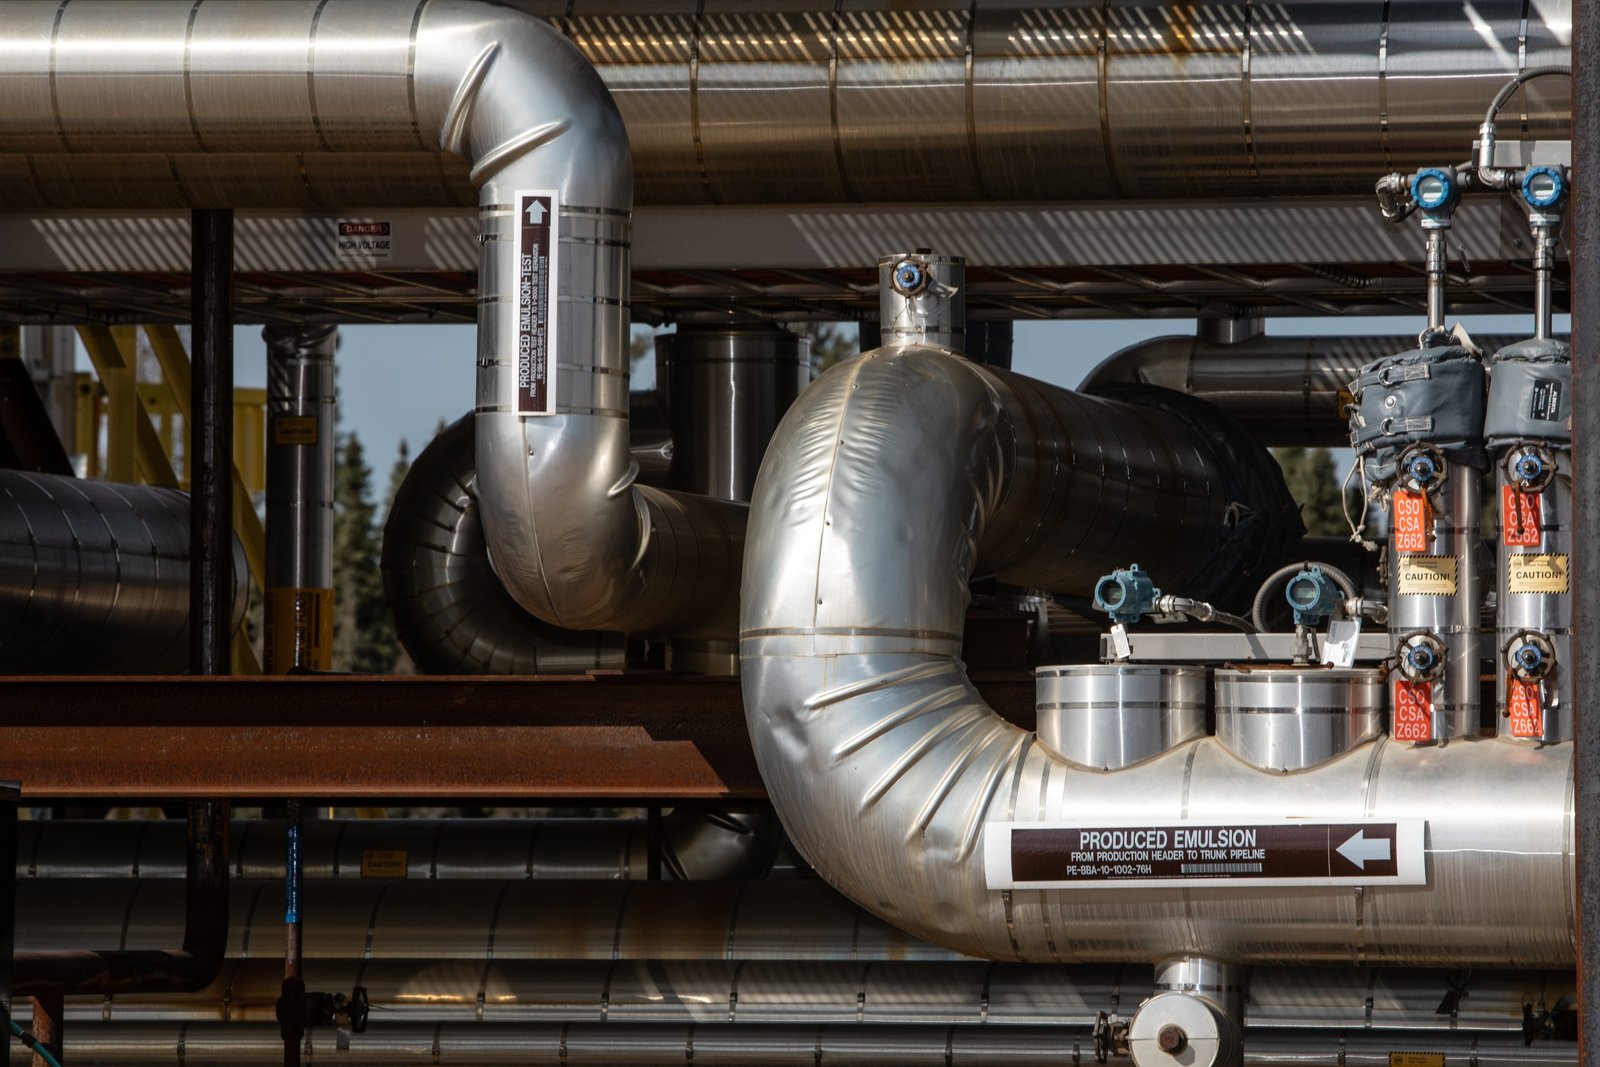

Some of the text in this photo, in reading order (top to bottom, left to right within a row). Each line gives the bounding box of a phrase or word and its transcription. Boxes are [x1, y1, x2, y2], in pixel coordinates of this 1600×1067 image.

[346, 225, 383, 233] DANGER
[339, 241, 390, 249] HIGH VOLTAGE
[532, 306, 538, 314] TO
[520, 253, 532, 388] PRODUCED EMULSION-TEST
[1398, 499, 1420, 515] CSO
[1509, 494, 1535, 509] CSO
[1399, 517, 1420, 532] CSA
[1509, 511, 1535, 526] CSA
[1398, 534, 1423, 549] Z662
[1405, 572, 1450, 581] CAUTION!
[1516, 571, 1562, 579] CAUTION!
[1399, 689, 1425, 704] CSO
[1512, 685, 1534, 700] CSO
[1399, 706, 1424, 721] CSA
[1513, 701, 1537, 718] CSA
[1396, 723, 1427, 738] Z662
[1512, 718, 1540, 734] Z662
[1080, 829, 1256, 850] PRODUCED EMULSION
[1071, 849, 1265, 862] FROM PRODUCTION HEADER TO TRUNK PIPELINE
